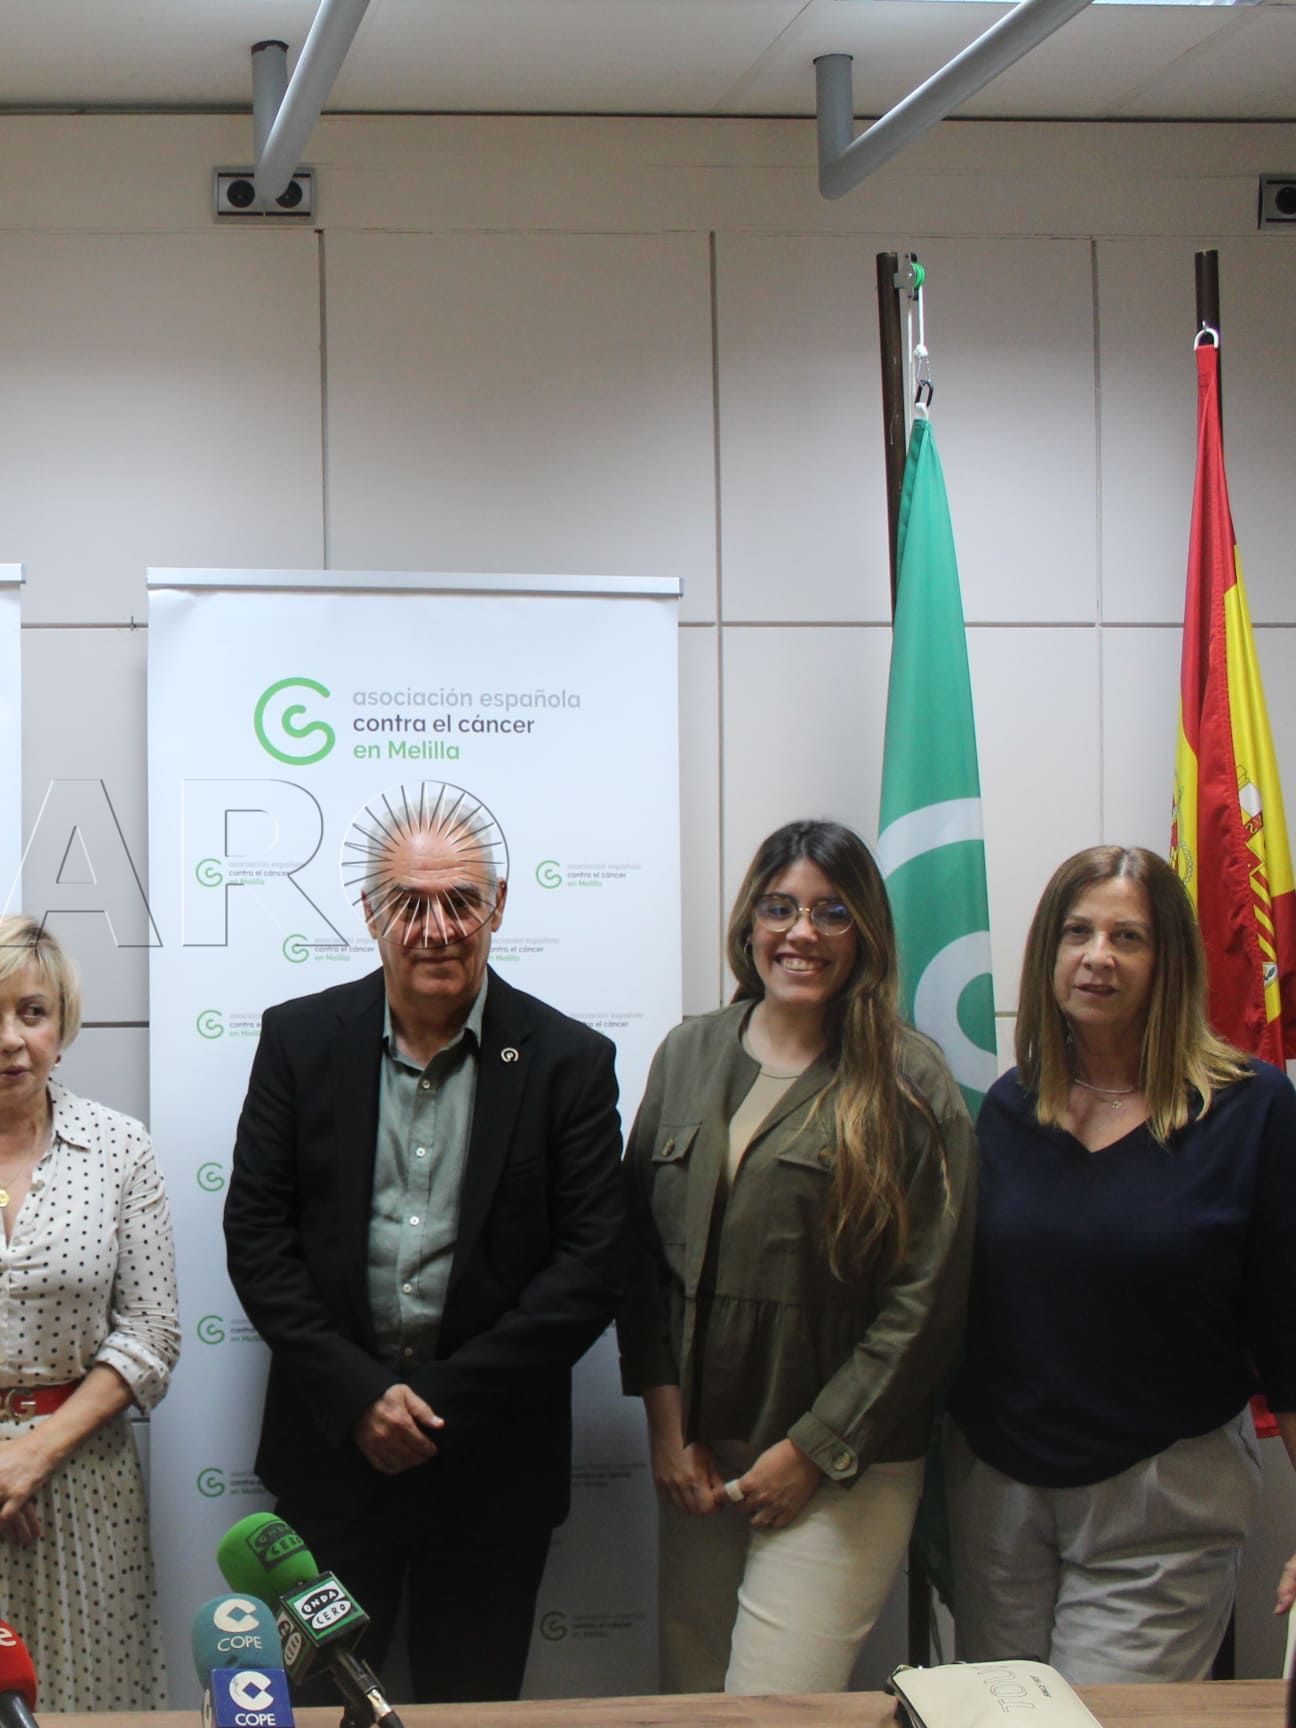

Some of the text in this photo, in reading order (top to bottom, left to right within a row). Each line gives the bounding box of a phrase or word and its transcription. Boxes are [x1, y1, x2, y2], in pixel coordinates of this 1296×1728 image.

[352, 686, 582, 711] asociación española
[352, 712, 535, 734] contra el cáncer
[352, 739, 461, 761] en Melilla
[302, 1590, 339, 1614] ONDA
[316, 1602, 347, 1626] CERO
[217, 1635, 263, 1653] COPE
[234, 1713, 277, 1727] COPE
